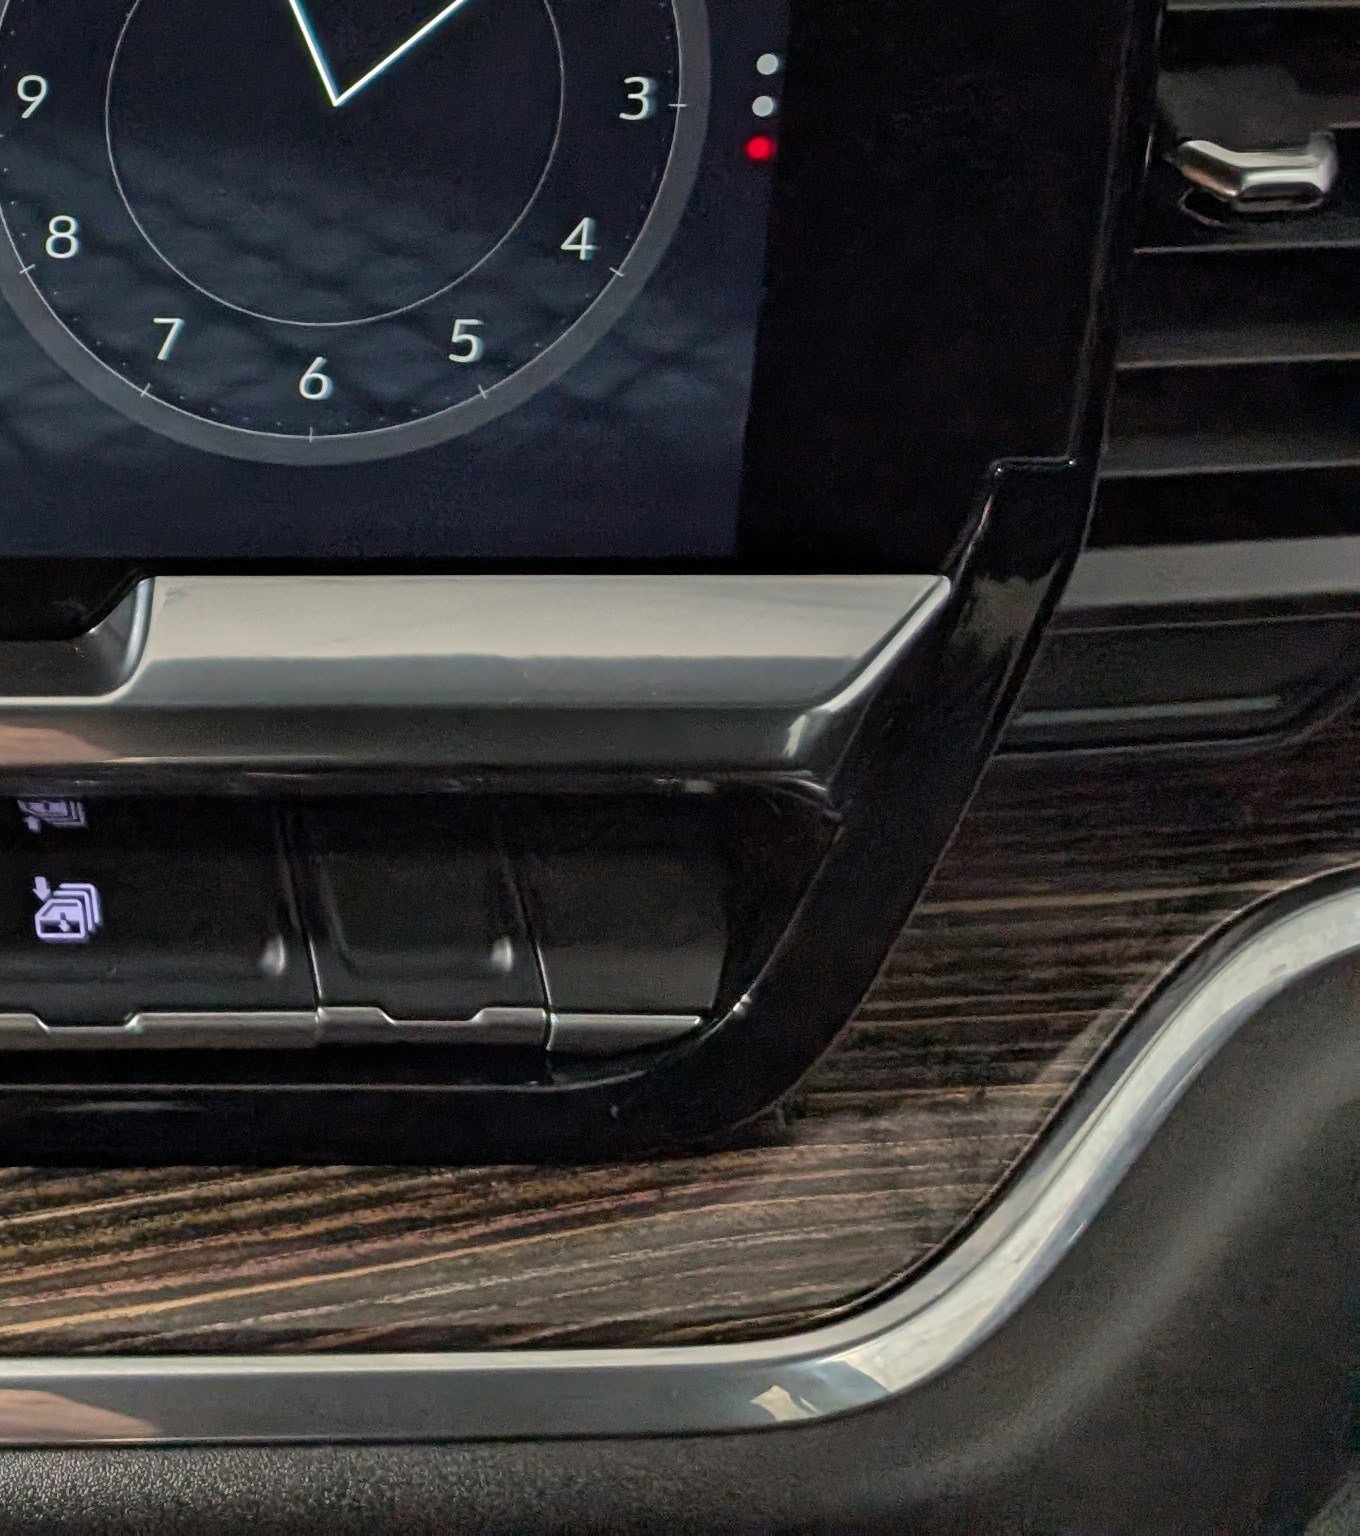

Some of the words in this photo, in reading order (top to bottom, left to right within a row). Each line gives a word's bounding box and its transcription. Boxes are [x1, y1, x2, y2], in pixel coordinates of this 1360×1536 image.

[17, 74, 48, 119] 9
[619, 76, 651, 121] 3
[45, 215, 79, 259] 8
[560, 217, 595, 261] 4
[153, 317, 184, 360] 7
[448, 318, 481, 363] 5
[299, 356, 332, 400] 6
